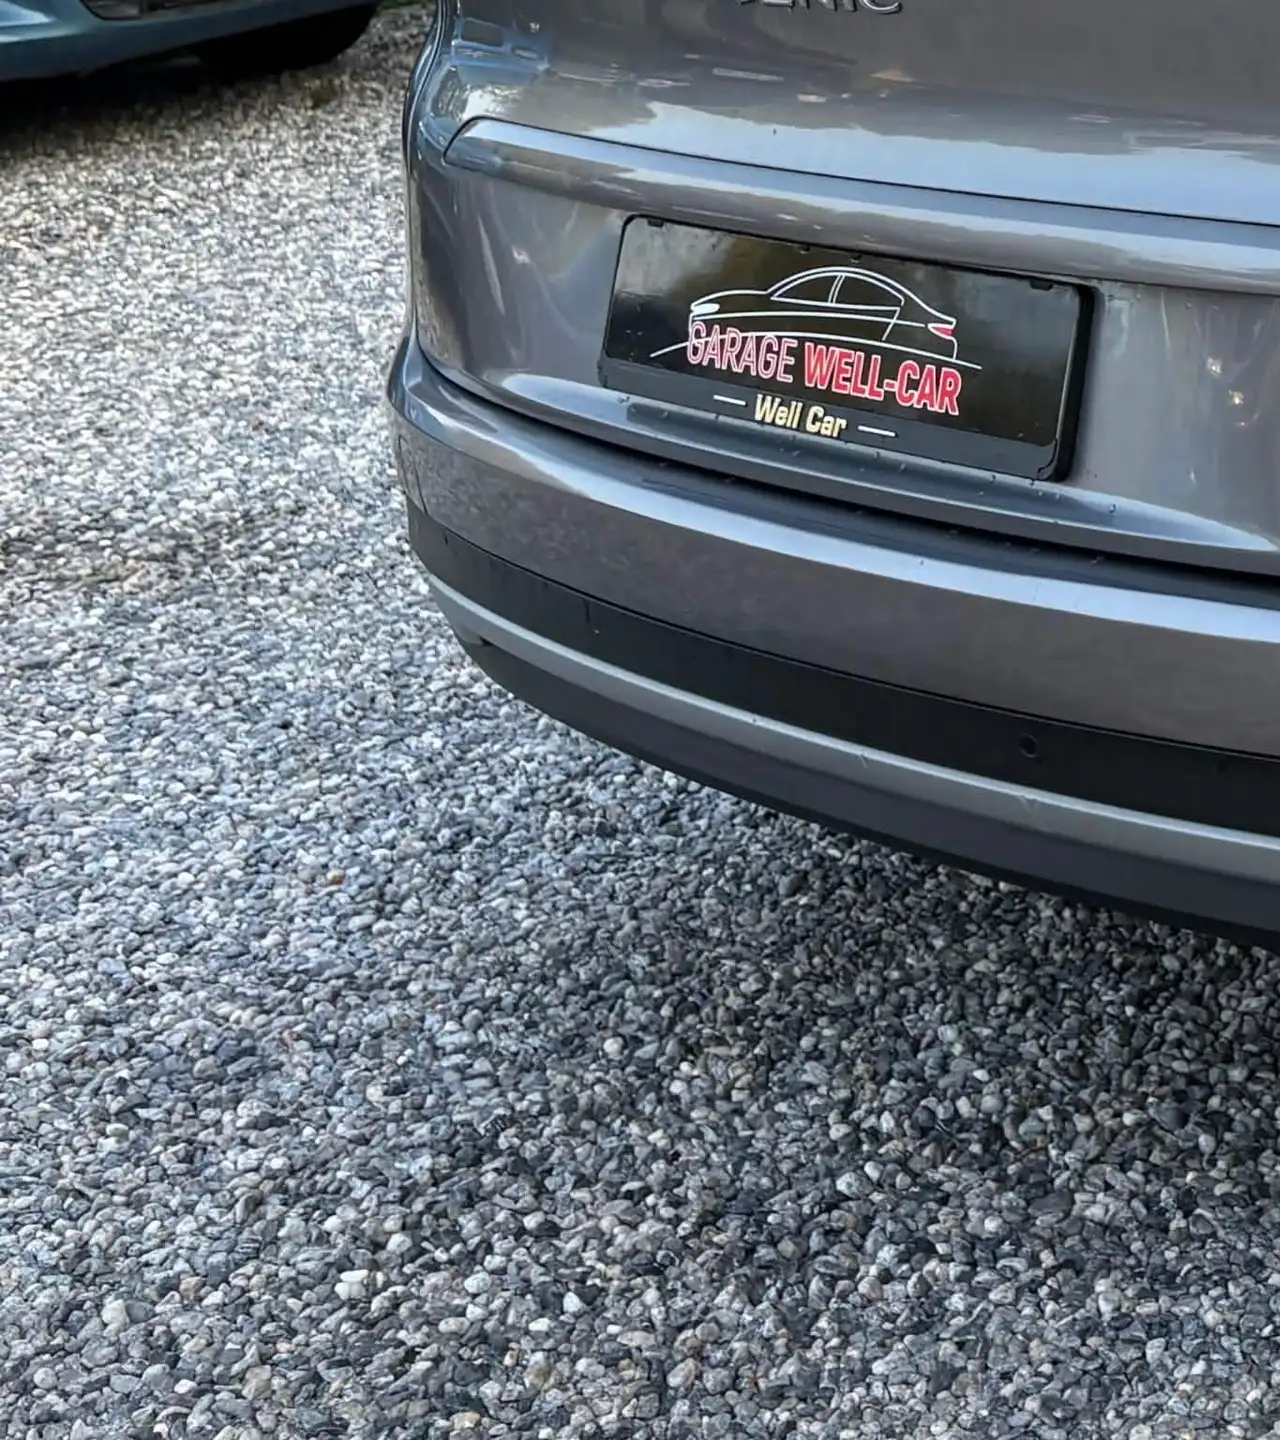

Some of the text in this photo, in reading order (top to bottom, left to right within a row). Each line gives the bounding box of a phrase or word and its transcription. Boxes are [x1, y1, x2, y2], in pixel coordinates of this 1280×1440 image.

[687, 321, 962, 416] GARAGE WELL-CAR
[754, 394, 847, 437] Well Car
